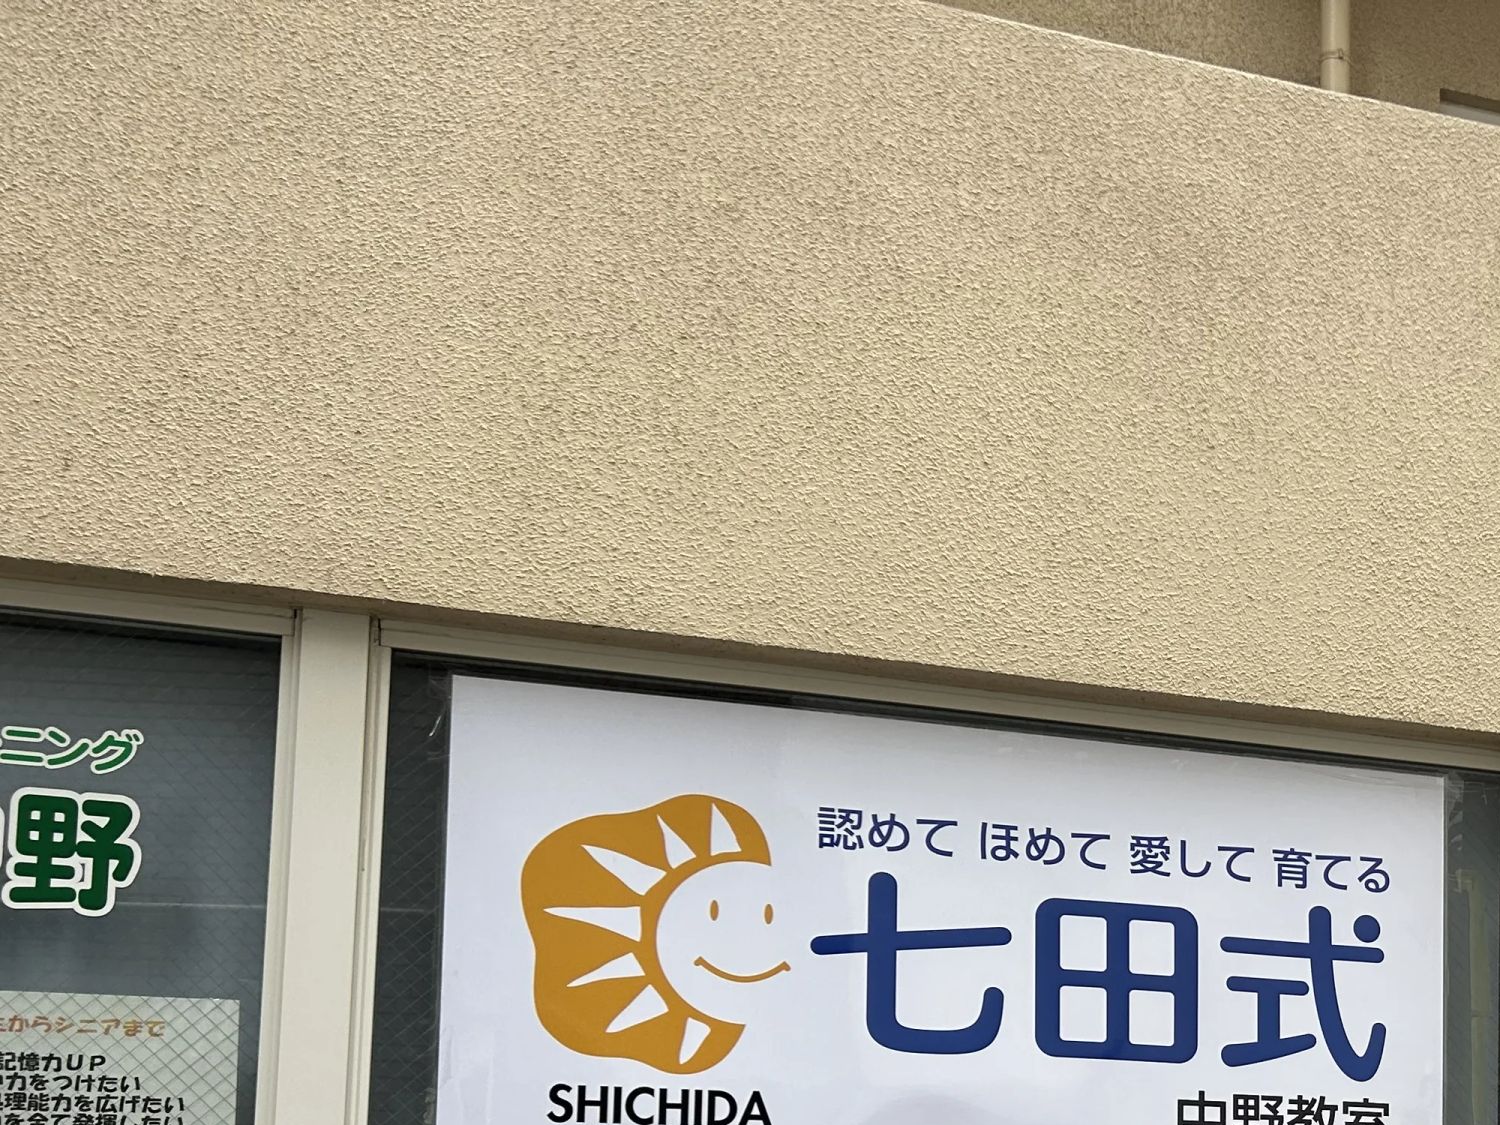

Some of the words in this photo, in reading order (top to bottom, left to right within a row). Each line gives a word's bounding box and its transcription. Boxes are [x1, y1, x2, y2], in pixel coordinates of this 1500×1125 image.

[817, 806, 958, 858] 認めて
[979, 821, 1110, 870] ほめて
[1129, 835, 1255, 883] 愛して
[1271, 847, 1391, 893] 育てる
[810, 871, 1386, 1082] 七田式
[0, 1014, 165, 1037] からシニアまで
[0, 1073, 141, 1092] 力をつけたい
[0, 1093, 185, 1112] 理能力を広げたい
